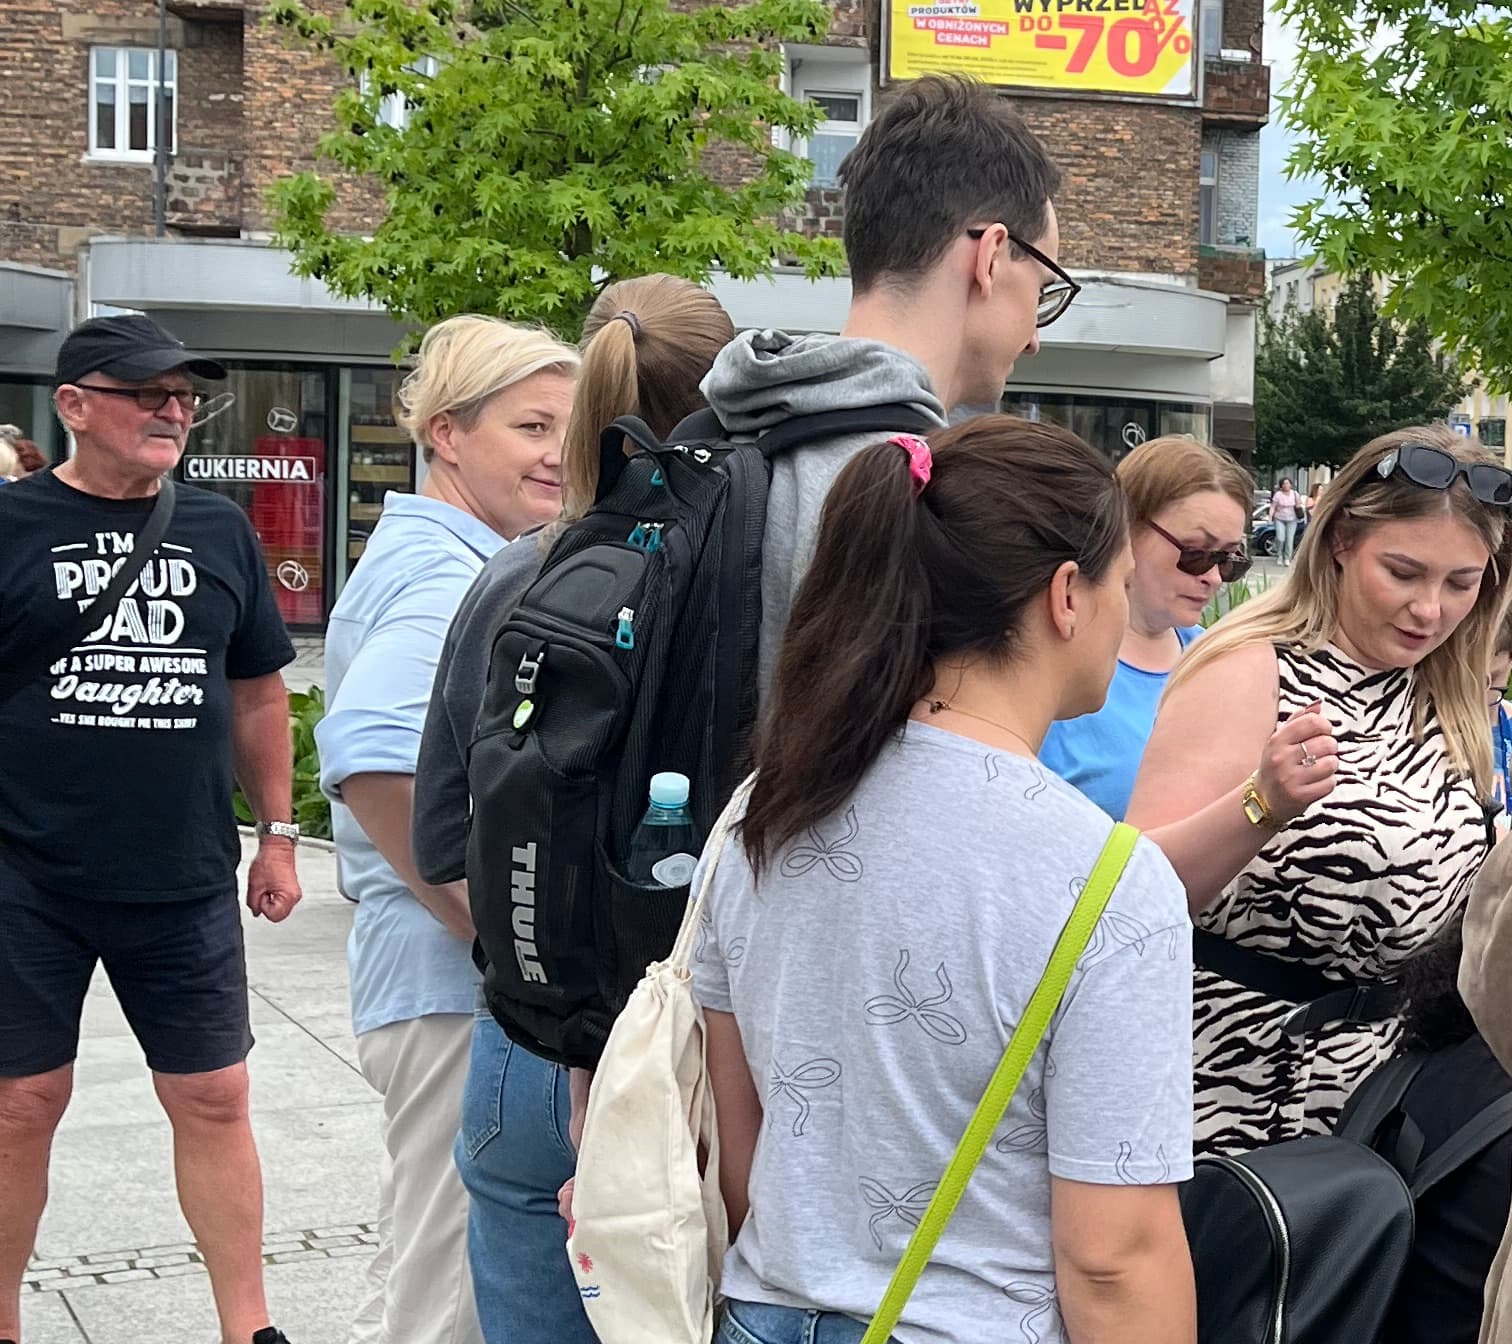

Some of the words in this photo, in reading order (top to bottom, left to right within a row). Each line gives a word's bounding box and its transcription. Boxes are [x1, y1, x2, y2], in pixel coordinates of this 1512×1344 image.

[916, 18, 926, 29] W
[1020, 15, 1052, 32] DO
[188, 458, 310, 480] CUKIERNIA
[95, 532, 135, 555] I'M
[71, 656, 82, 672] A
[85, 654, 136, 672] SUPER
[139, 657, 208, 674] AWESOME
[50, 674, 204, 715] Daughter
[511, 842, 548, 984] THULE
